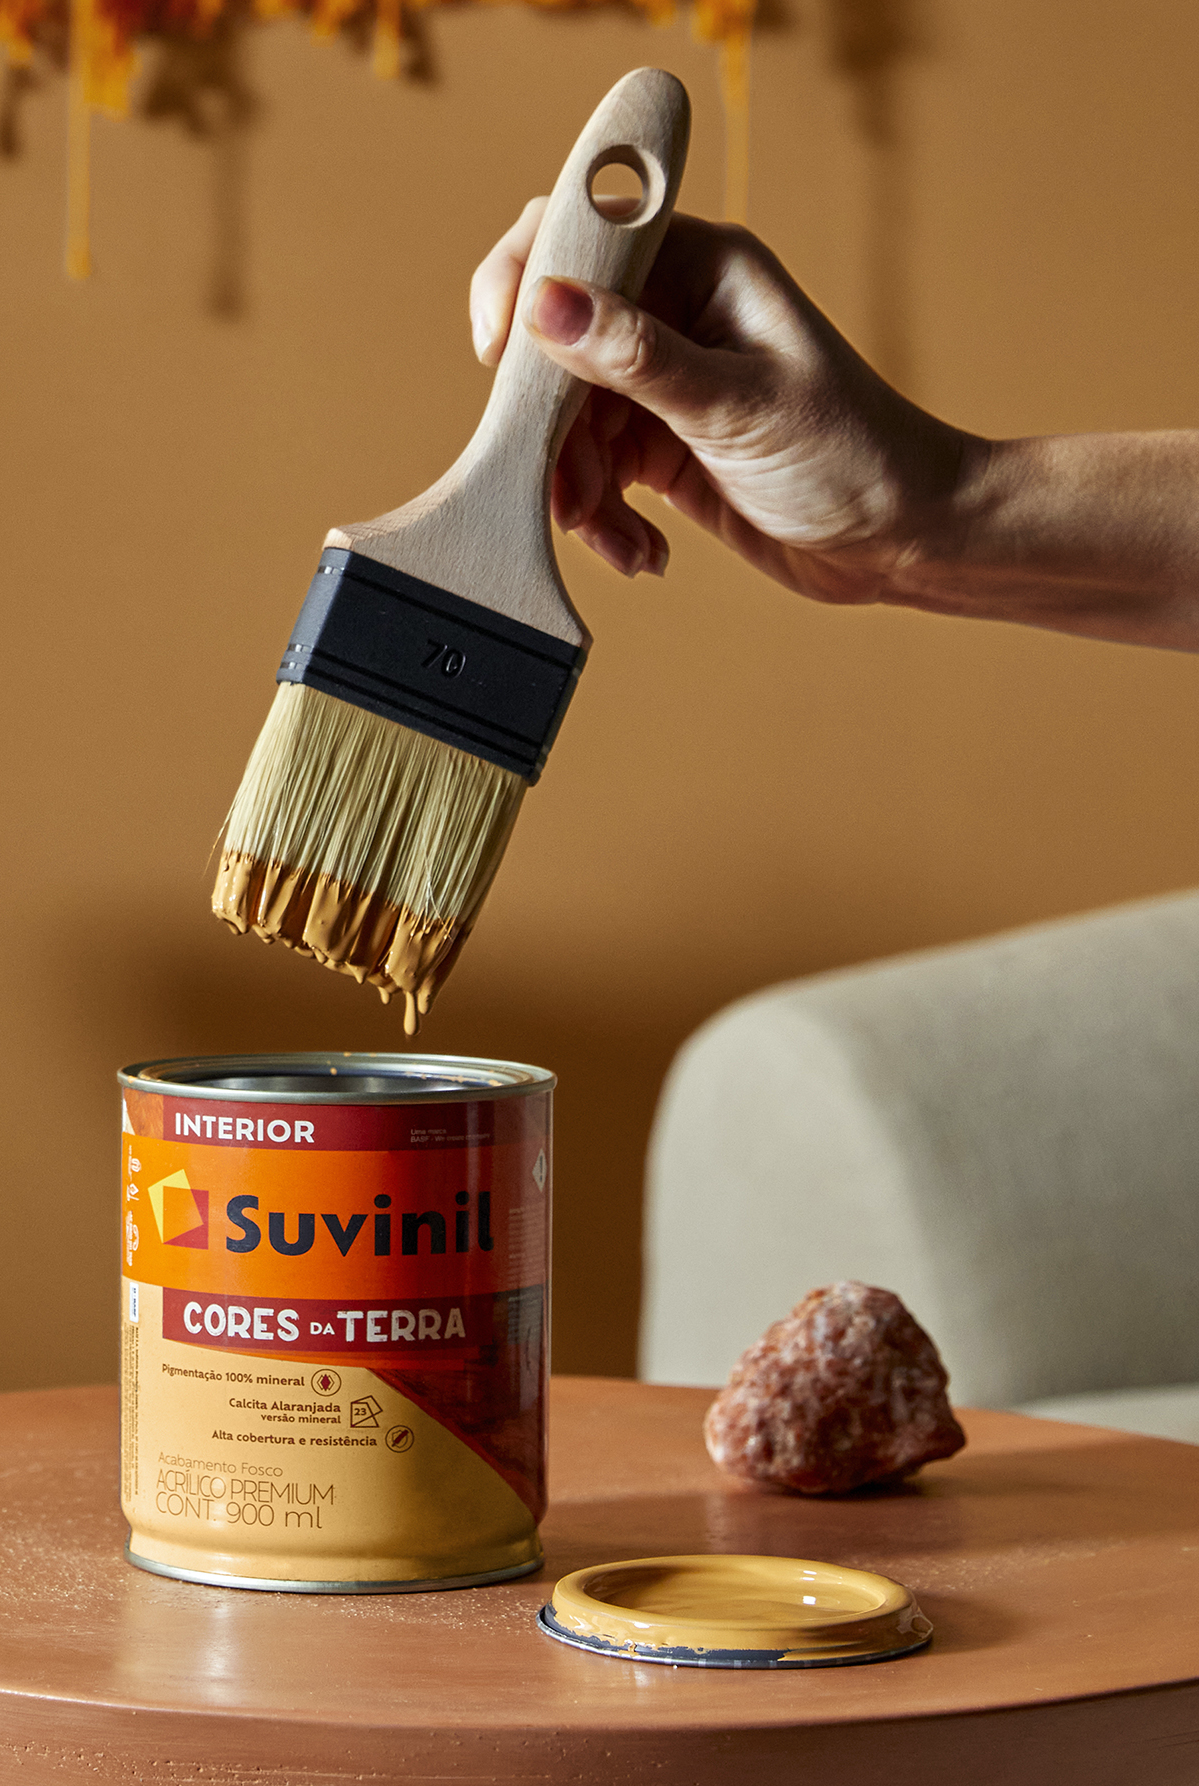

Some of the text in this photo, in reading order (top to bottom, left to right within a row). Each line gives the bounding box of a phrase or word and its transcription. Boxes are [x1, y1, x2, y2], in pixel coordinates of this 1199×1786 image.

[420, 638, 467, 679] 70
[174, 1112, 315, 1143] INTERIOR
[226, 1191, 495, 1257] Suvinil
[183, 1301, 466, 1342] CORES DA TERRA
[161, 1363, 305, 1386] Pigmentação 100% mineral
[228, 1398, 341, 1415] Calcita Alaranjada
[261, 1414, 342, 1424] versão mineral
[354, 1408, 367, 1416] 23
[212, 1430, 378, 1447] Alta cobertura e resistência
[157, 1451, 284, 1478] Acabamento Fosco
[156, 1468, 335, 1506] ACRÍLICO PREMIUM
[155, 1491, 323, 1529] CONT. 900 ml
